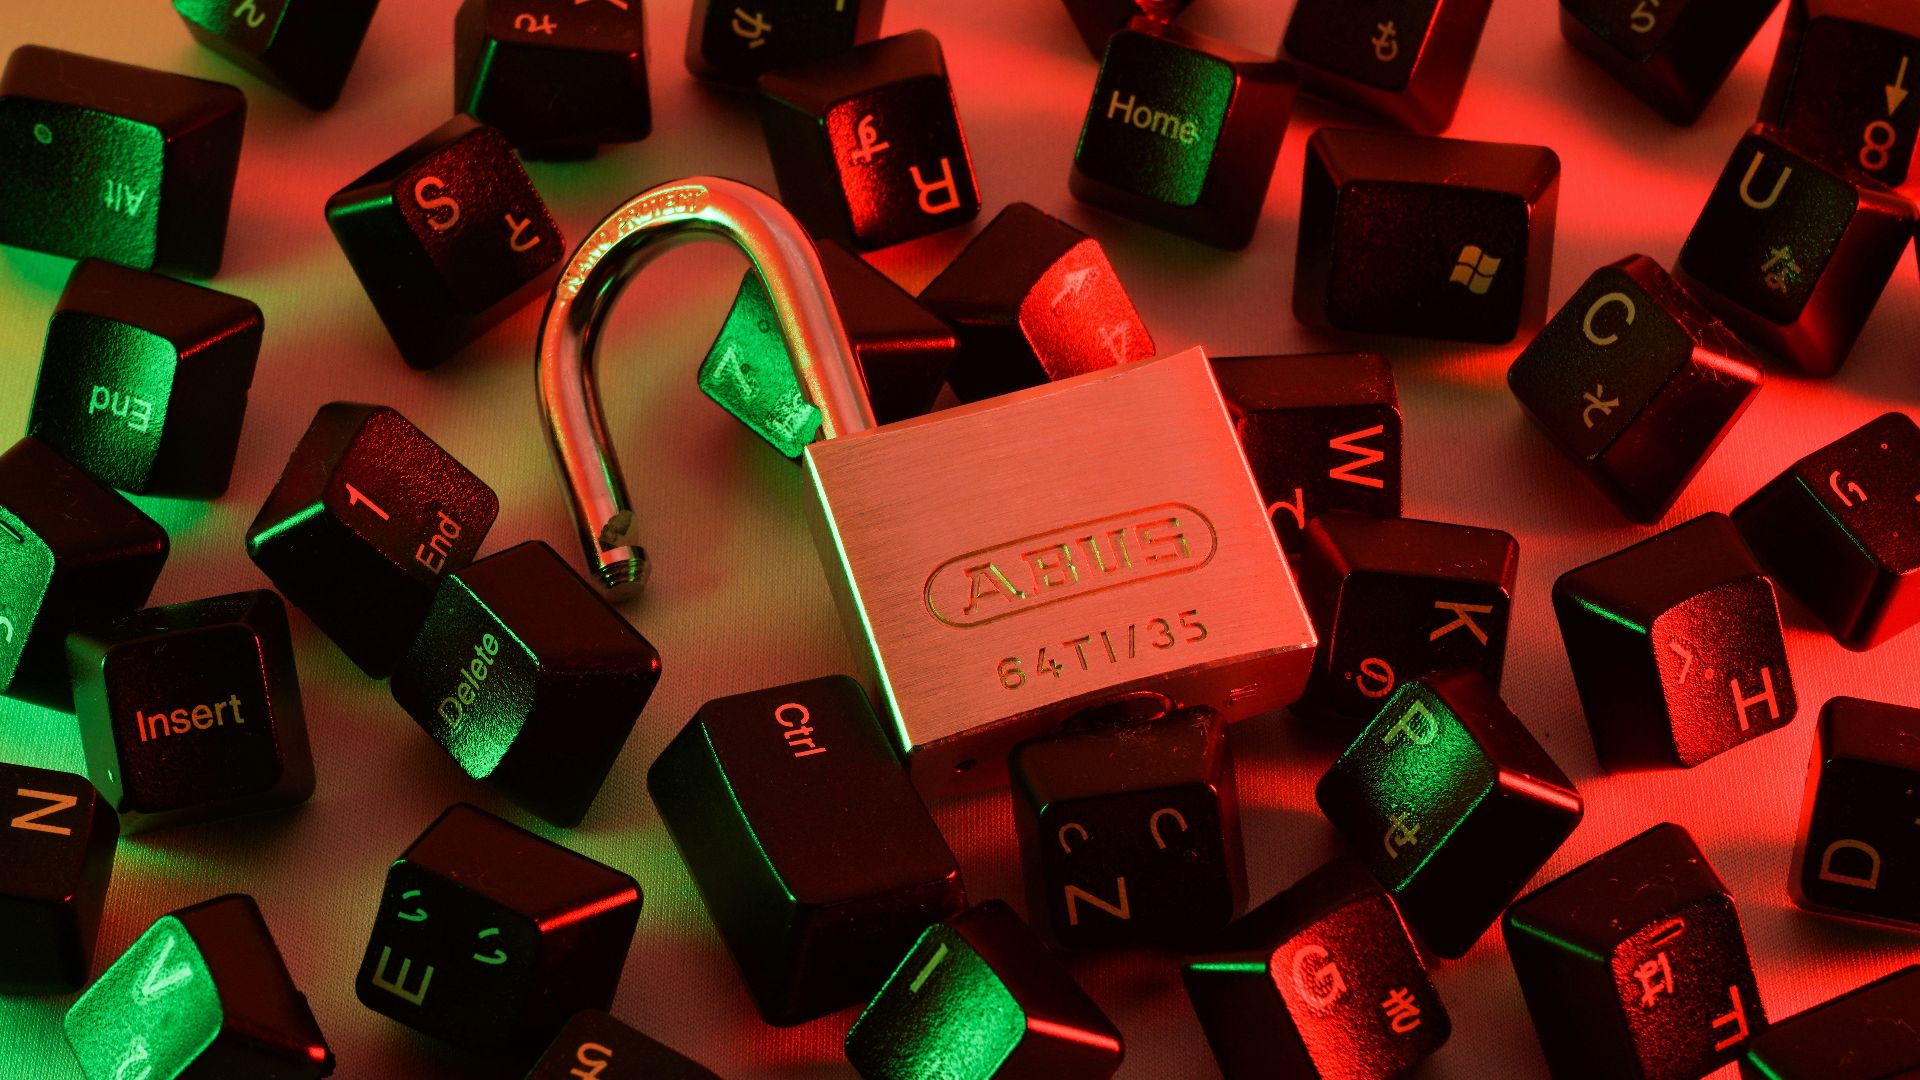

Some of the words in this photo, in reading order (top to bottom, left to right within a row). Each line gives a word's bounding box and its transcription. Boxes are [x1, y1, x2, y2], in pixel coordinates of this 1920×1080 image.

[731, 7, 773, 49] か
[1371, 20, 1398, 62] も
[850, 114, 890, 166] す
[1107, 90, 1201, 146] Home
[1859, 119, 1896, 171] 8
[104, 179, 147, 216] Alt
[414, 176, 460, 231] S
[908, 157, 961, 215] R
[1739, 151, 1793, 209] U
[504, 213, 540, 253] と
[1760, 245, 1801, 294] な
[1583, 292, 1636, 346] C
[87, 385, 153, 432] End
[1582, 383, 1620, 429] そ
[1330, 424, 1384, 489] W
[346, 482, 390, 521] 1
[1829, 470, 1867, 507] り
[414, 511, 462, 576] End
[964, 517, 1192, 615] ABUS
[997, 609, 1207, 689] 64TI/35
[1430, 600, 1493, 647] K
[437, 631, 500, 729] Delete
[1356, 657, 1395, 698] の
[1730, 667, 1780, 732] H
[136, 692, 245, 742] Insert
[774, 702, 826, 758] Ctrl
[1383, 699, 1439, 747] P
[10, 787, 78, 836] N
[1384, 809, 1420, 860] せ
[1819, 839, 1881, 889] D
[1064, 876, 1131, 927] Z
[135, 936, 193, 1006] V
[371, 945, 434, 1006] E
[1291, 944, 1349, 1013] G
[1381, 986, 1421, 1037] き
[1711, 984, 1751, 1053] F
